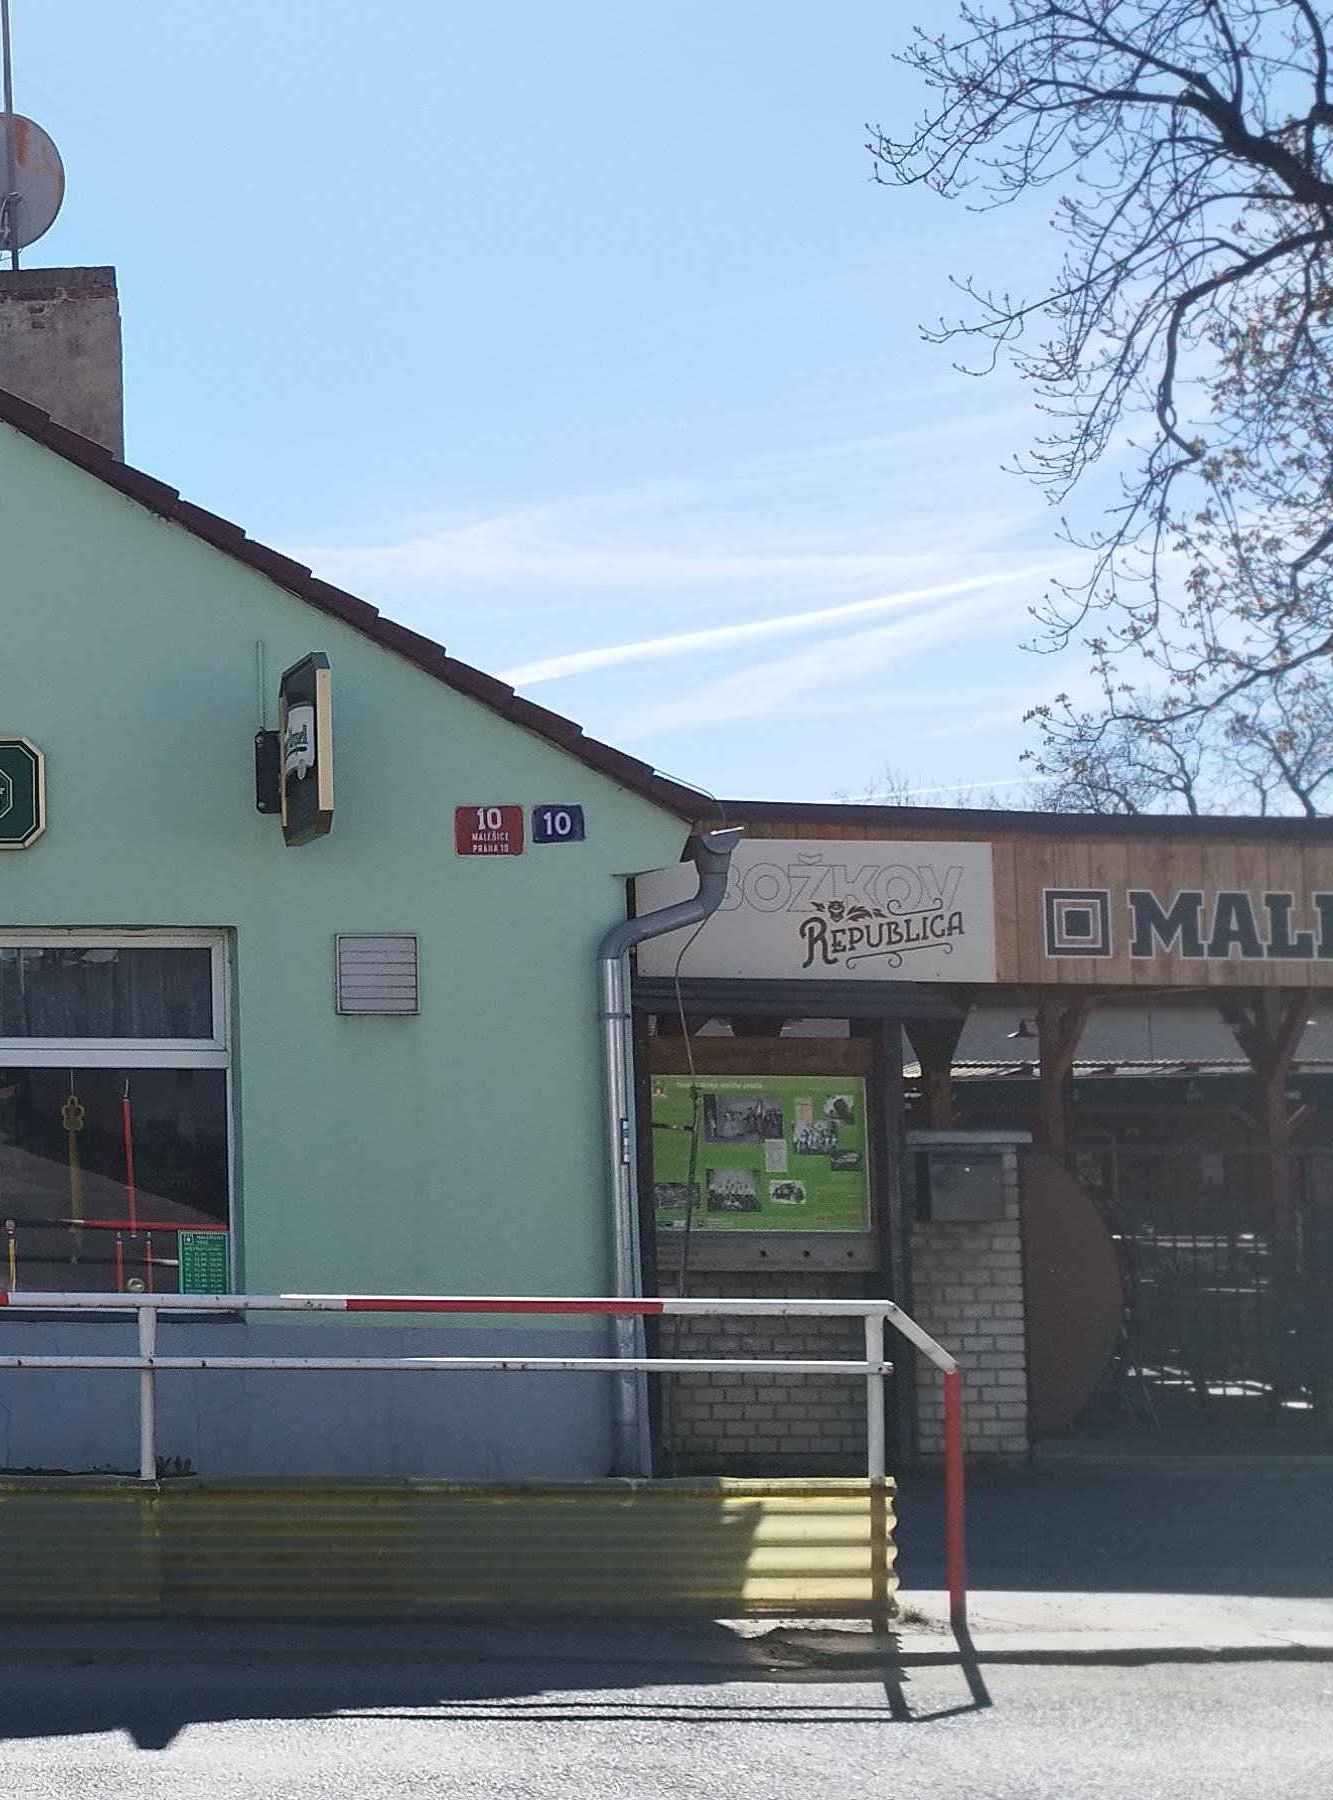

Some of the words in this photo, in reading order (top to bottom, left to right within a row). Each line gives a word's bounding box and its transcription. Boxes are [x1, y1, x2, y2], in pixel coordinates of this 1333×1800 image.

[476, 807, 502, 830] 10
[543, 811, 572, 835] 10
[471, 830, 510, 842] MALEŠICE
[472, 844, 498, 853] PRAHA
[500, 844, 509, 853] 10
